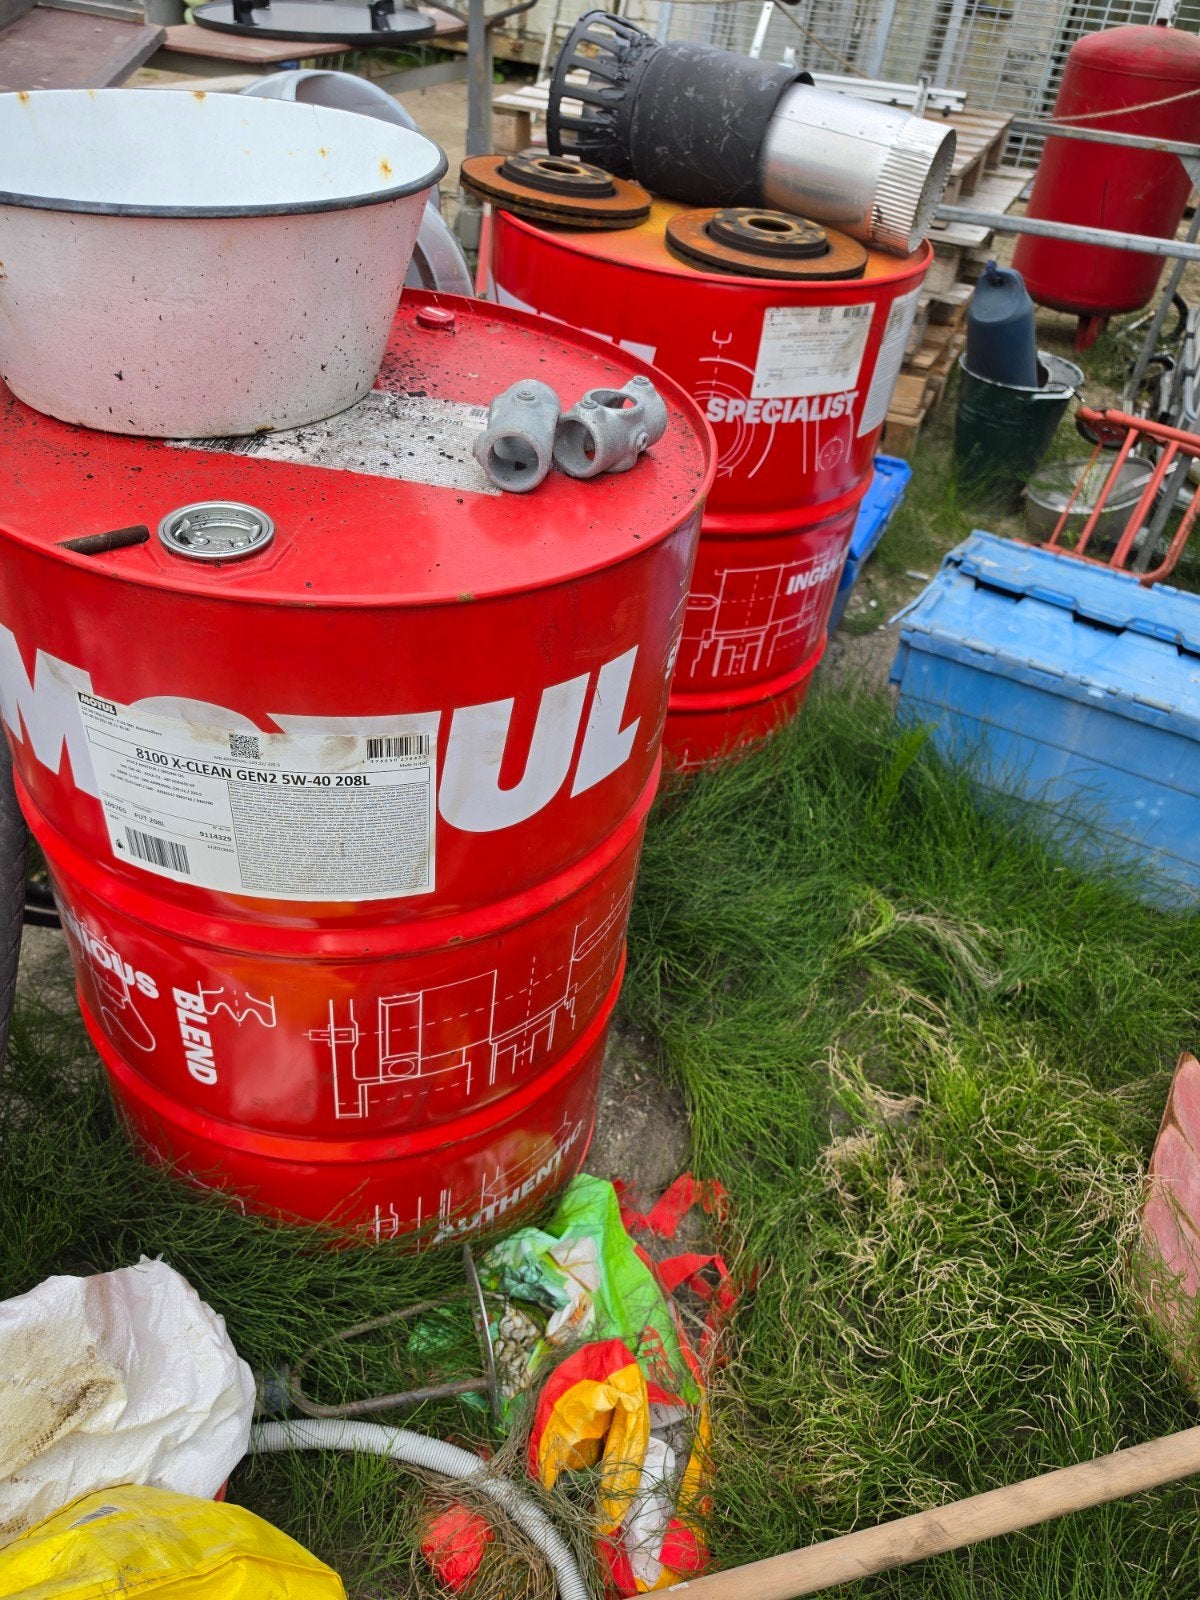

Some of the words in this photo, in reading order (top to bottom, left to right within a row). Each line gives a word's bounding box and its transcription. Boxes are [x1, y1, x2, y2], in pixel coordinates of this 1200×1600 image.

[706, 391, 860, 424] SPECIALIST
[79, 692, 117, 715] MOTUL
[0, 622, 641, 833] MUL
[135, 747, 168, 766] 8100
[172, 757, 232, 779] X-CLEAN
[236, 769, 277, 784] GEN2
[282, 773, 331, 787] 5W-40
[335, 774, 371, 787] 208L
[199, 831, 232, 842] 9114329
[172, 986, 218, 1086] BLEND
